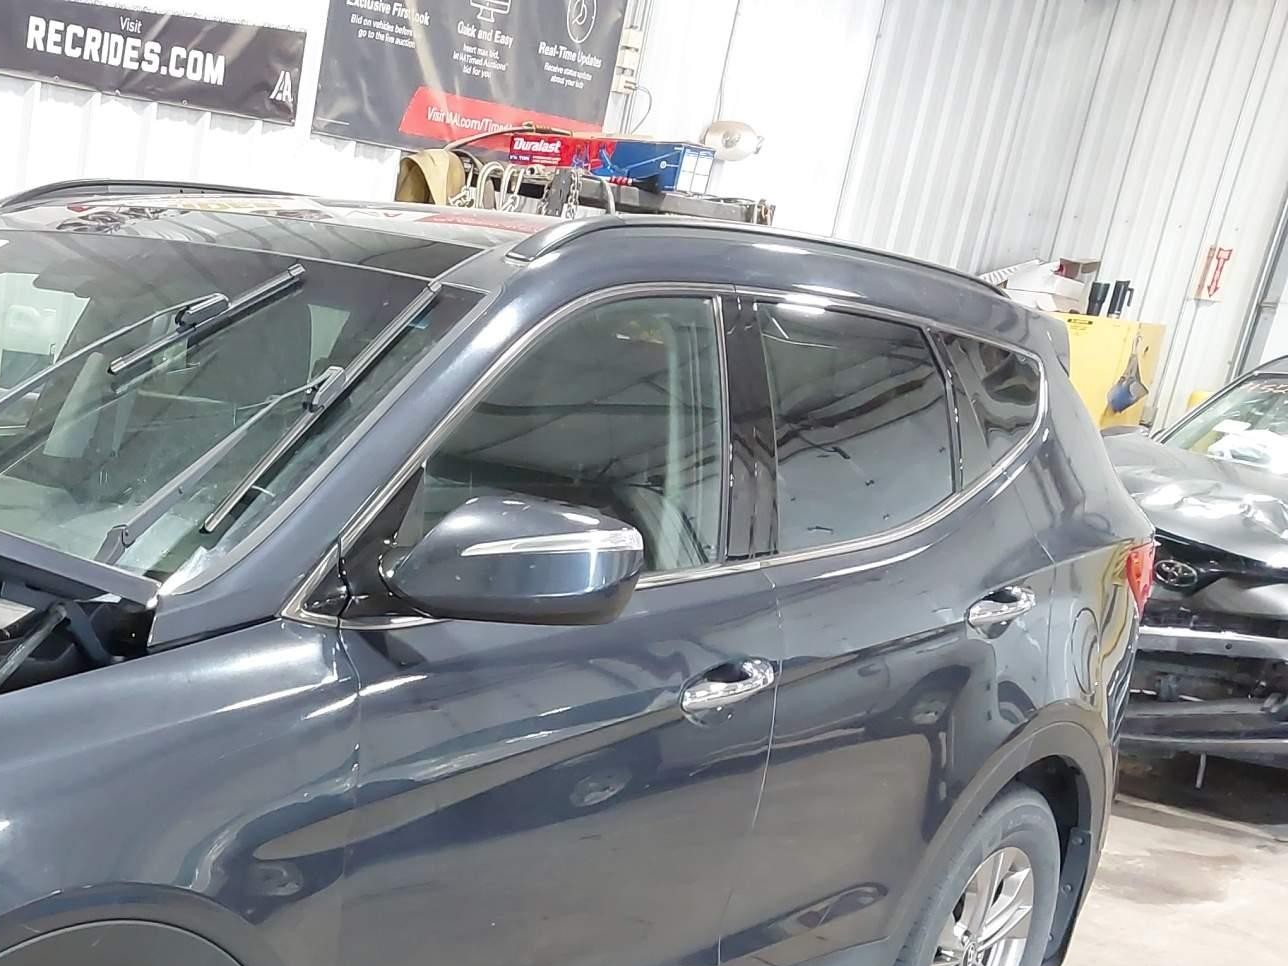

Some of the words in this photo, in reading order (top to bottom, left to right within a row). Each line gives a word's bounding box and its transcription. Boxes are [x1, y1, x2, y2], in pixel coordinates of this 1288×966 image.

[120, 16, 143, 34] Visit
[457, 20, 477, 38] Quick
[477, 29, 493, 42] and
[494, 30, 514, 48] Easy
[26, 15, 225, 86] RECRIDES.COM
[538, 41, 577, 62] Real-Time
[577, 49, 602, 68] Updates
[513, 137, 561, 154] Duralast
